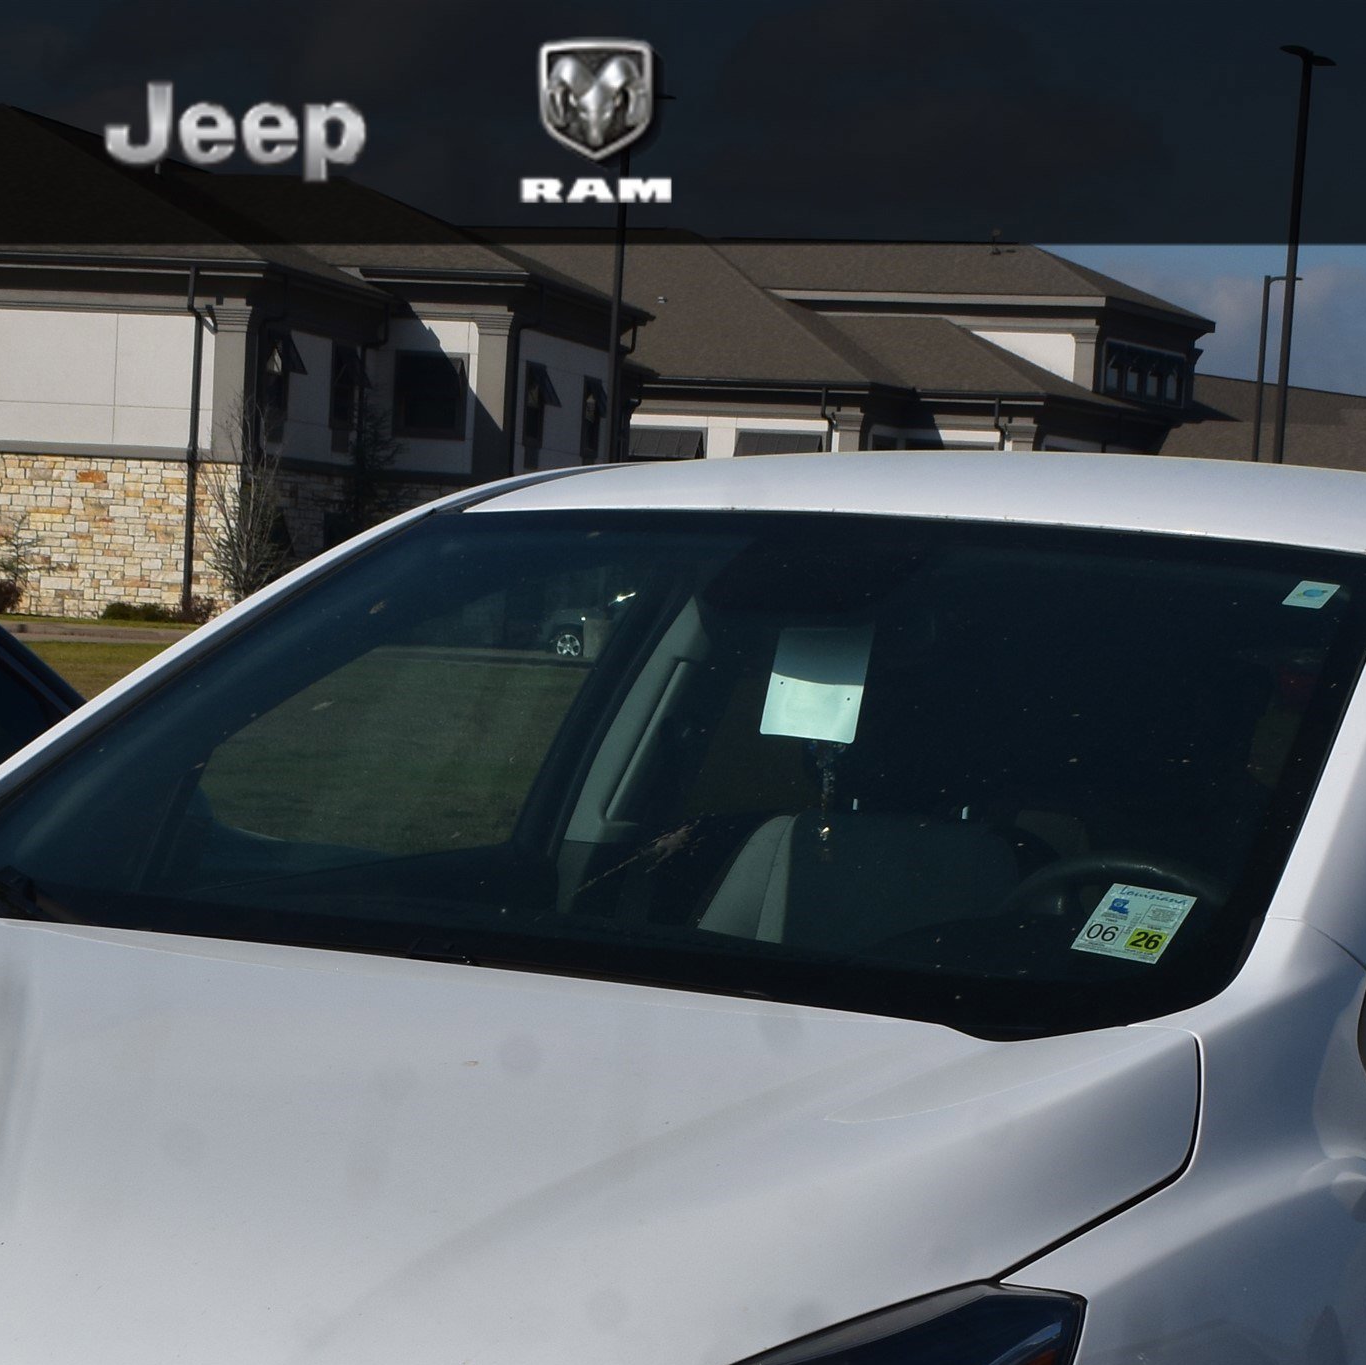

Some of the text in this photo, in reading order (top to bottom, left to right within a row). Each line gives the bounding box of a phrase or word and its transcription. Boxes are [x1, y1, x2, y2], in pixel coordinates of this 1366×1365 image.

[1120, 886, 1187, 906] Louisiana
[1086, 923, 1119, 942] 06
[1129, 931, 1163, 950] 26
